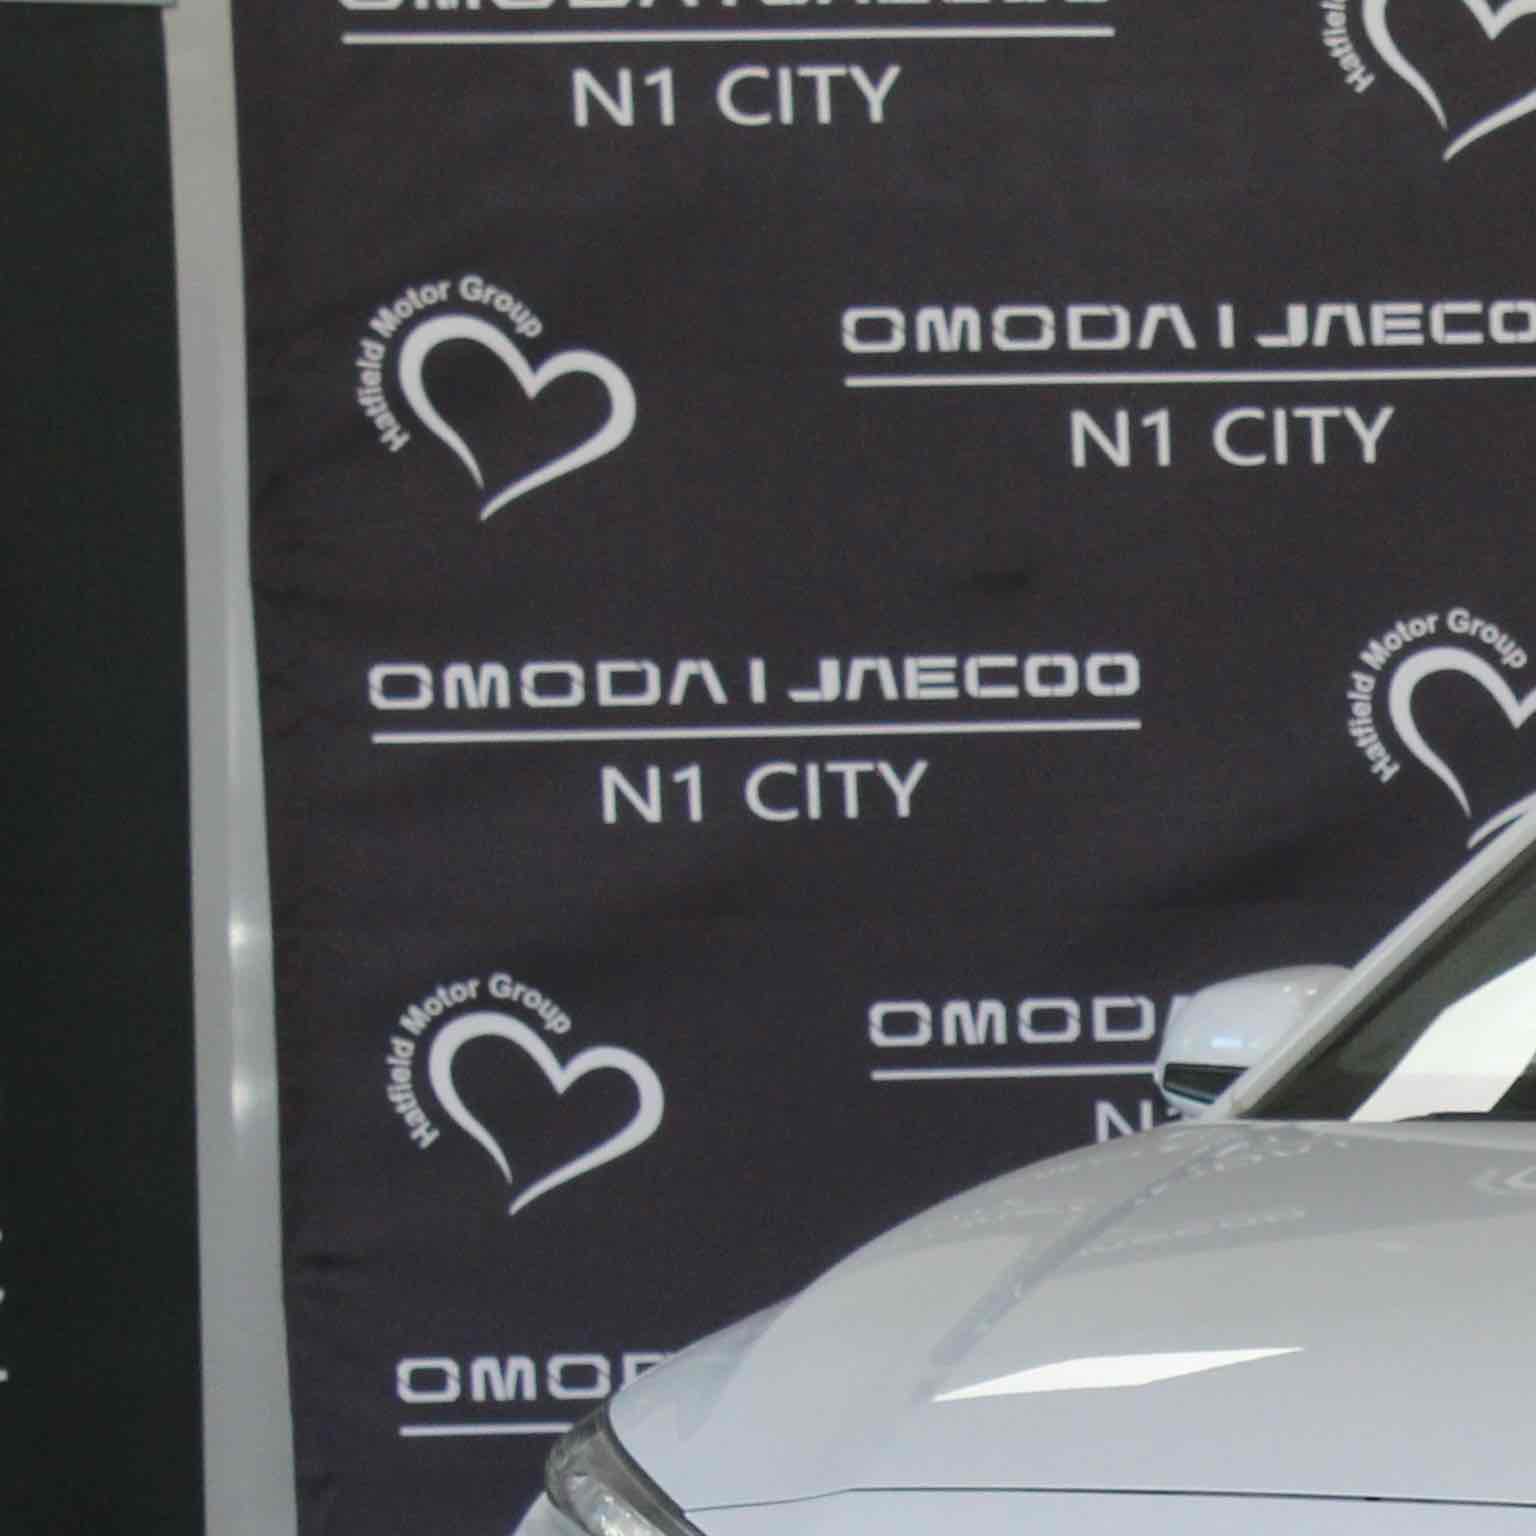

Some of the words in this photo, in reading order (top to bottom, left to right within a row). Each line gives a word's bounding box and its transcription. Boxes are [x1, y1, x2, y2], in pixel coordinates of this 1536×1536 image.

[1320, 0, 1376, 94] Hatfiel
[572, 67, 674, 127] N1
[716, 65, 901, 126] CITY
[368, 280, 450, 338] Motor
[458, 274, 543, 338] Group
[842, 303, 1196, 353] OMODA
[355, 338, 411, 452] Hatfield
[1071, 409, 1171, 467] N1
[1213, 406, 1394, 467] CITY
[1359, 613, 1439, 671] Motor
[1446, 607, 1528, 669] Group
[368, 659, 727, 710] OMODA
[788, 653, 1140, 702] JAECOO
[1346, 670, 1401, 784] Hatfield
[601, 764, 702, 824] N1
[745, 760, 928, 821] CITY
[398, 978, 480, 1036] Motor
[488, 972, 572, 1035] Group
[868, 994, 1193, 1047] OMOD
[385, 1035, 441, 1150] Hatfield
[396, 1351, 668, 1403] OMO
